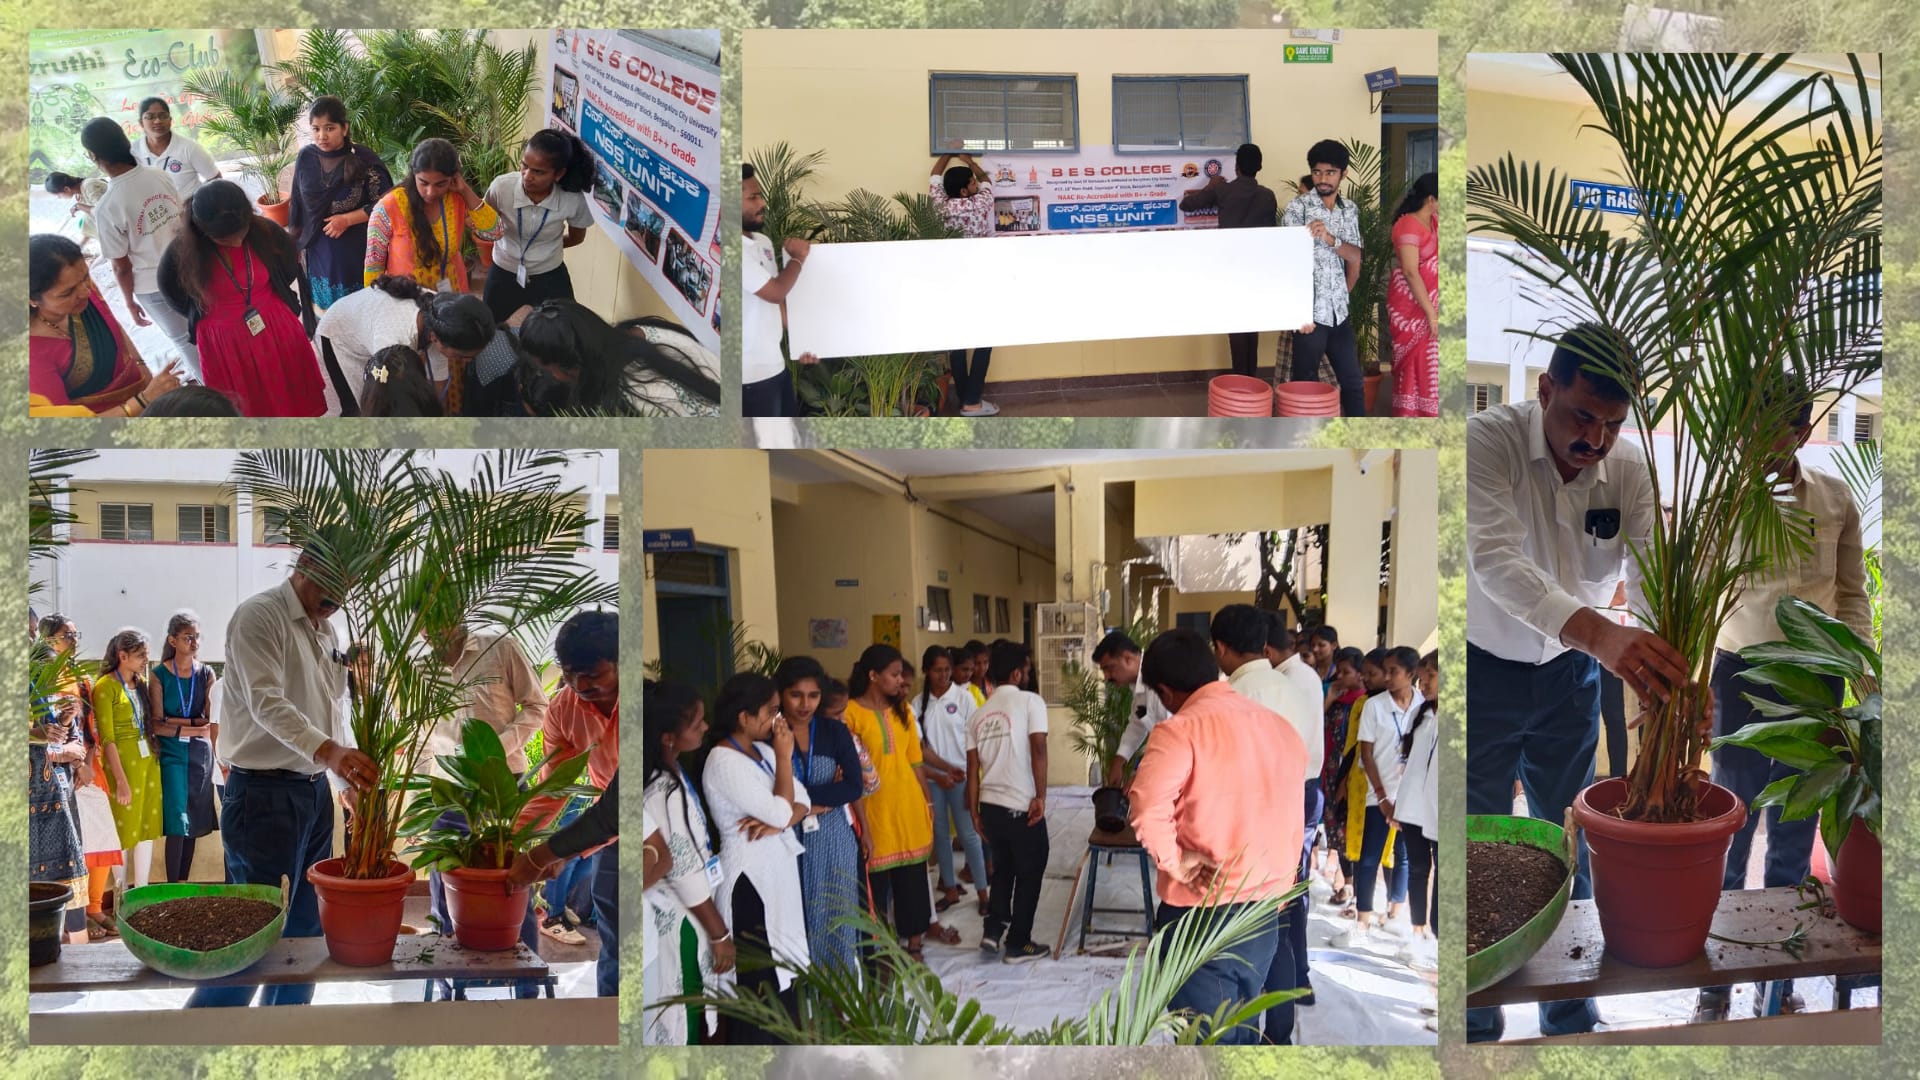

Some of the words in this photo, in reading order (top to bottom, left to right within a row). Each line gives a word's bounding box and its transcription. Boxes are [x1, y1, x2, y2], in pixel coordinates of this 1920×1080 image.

[123, 35, 220, 80] Eco-Club
[1295, 47, 1308, 55] SAVE
[1309, 47, 1329, 55] ENERGY
[586, 37, 596, 56] B
[609, 50, 621, 69] S
[626, 56, 717, 115] COLLEGE
[678, 110, 689, 124] City
[688, 116, 719, 138] University
[636, 122, 652, 139] with
[653, 130, 669, 148] B++
[671, 143, 697, 167] Grade
[594, 129, 625, 165] NSS
[629, 157, 676, 203] UNIT
[1051, 167, 1063, 178] B
[1068, 167, 1079, 177] E
[1083, 167, 1095, 177] S
[1100, 164, 1172, 176] COLLEGE
[1578, 186, 1601, 204] NO
[1070, 213, 1109, 224] NSS
[1114, 211, 1156, 221] UNIT
